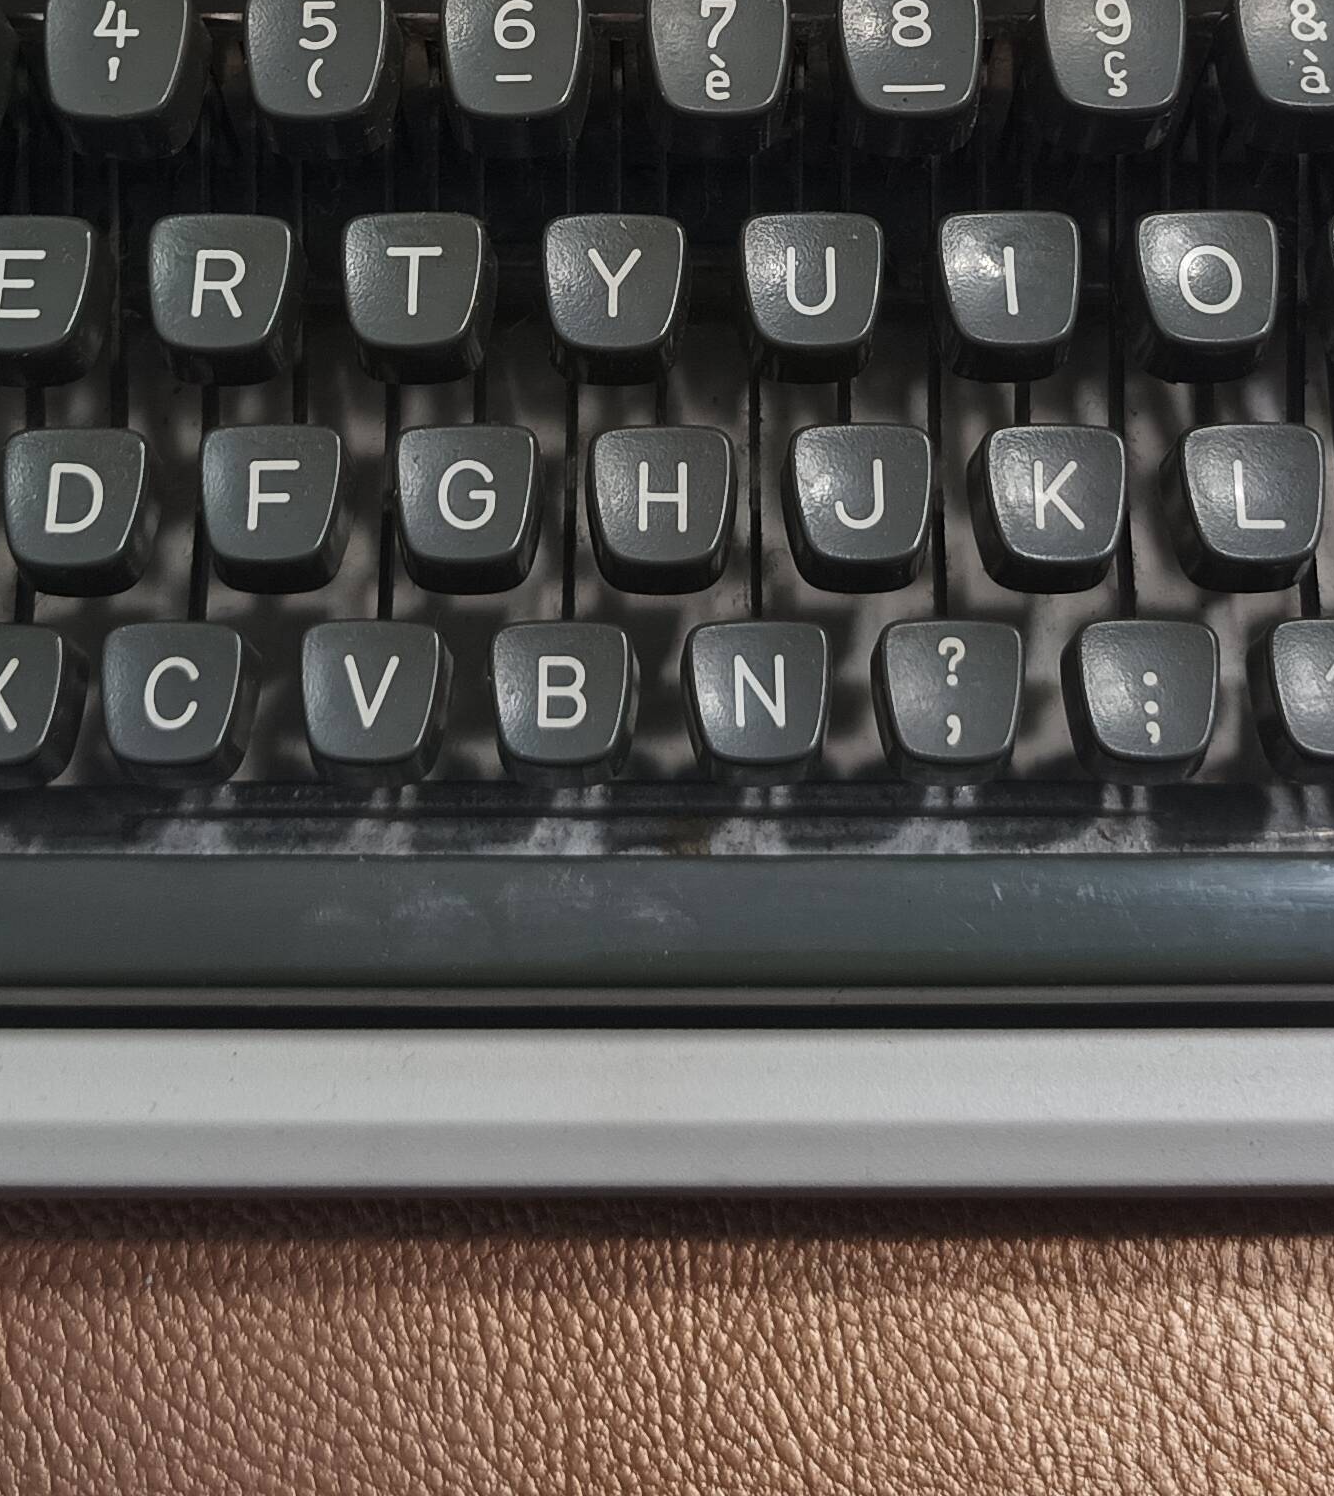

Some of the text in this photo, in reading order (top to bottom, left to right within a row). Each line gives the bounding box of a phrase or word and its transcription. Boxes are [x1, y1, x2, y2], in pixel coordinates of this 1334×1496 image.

[93, 0, 140, 49] 4
[298, 1, 337, 50] 5
[493, 0, 536, 50] 6
[705, 53, 730, 101] è
[1300, 48, 1330, 94] à
[191, 249, 246, 318] R
[386, 245, 444, 316] T
[587, 248, 642, 318] Y
[785, 245, 837, 316] U
[1002, 245, 1020, 317] I
[1177, 244, 1243, 315] O
[45, 462, 104, 533] D
[247, 460, 300, 531] F
[438, 459, 496, 530] G
[638, 461, 688, 533] H
[833, 458, 885, 531] J
[1031, 459, 1086, 531] K
[1232, 459, 1286, 530] L
[144, 656, 199, 729] C
[344, 654, 400, 728] V
[537, 655, 587, 728] B
[734, 654, 786, 728] N
[938, 637, 966, 686] ?
